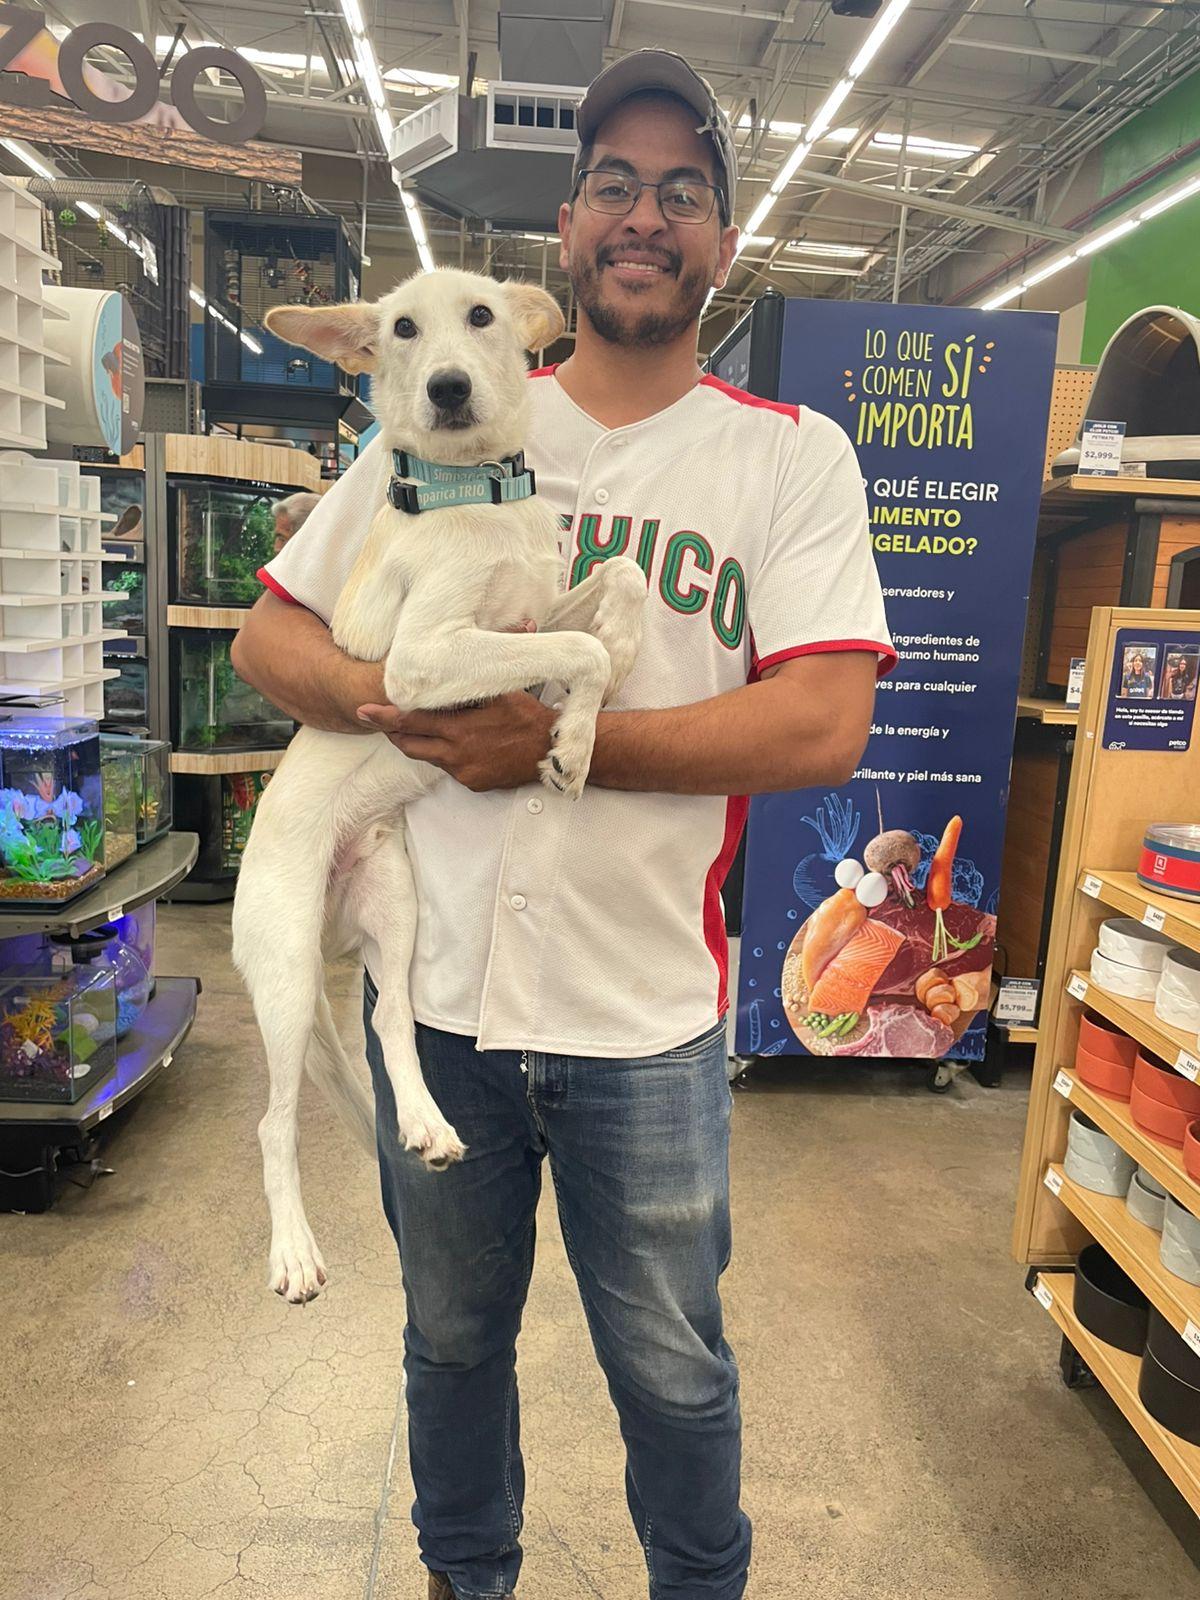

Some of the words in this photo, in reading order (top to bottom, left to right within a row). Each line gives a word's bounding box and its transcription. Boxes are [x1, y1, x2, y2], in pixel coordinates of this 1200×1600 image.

[865, 328, 887, 359] LO
[897, 330, 935, 362] QUE
[862, 365, 932, 398] COMEN
[942, 334, 977, 399] SÍ
[857, 401, 973, 450] IMPORTA
[458, 484, 485, 498] TRIO
[873, 476, 920, 498] QUÉ
[925, 480, 999, 502] ELEGIR
[558, 513, 746, 650] XICO
[947, 590, 955, 601] y
[892, 632, 963, 646] ingredientes
[965, 635, 980, 647] de
[933, 649, 980, 662] humano
[895, 681, 921, 692] para
[923, 681, 977, 694] cualquier
[885, 724, 895, 735] la
[897, 726, 940, 739] energía
[942, 728, 950, 739] y
[898, 772, 905, 783] y
[907, 770, 928, 783] piel
[930, 771, 953, 782] más
[955, 773, 982, 783] sana
